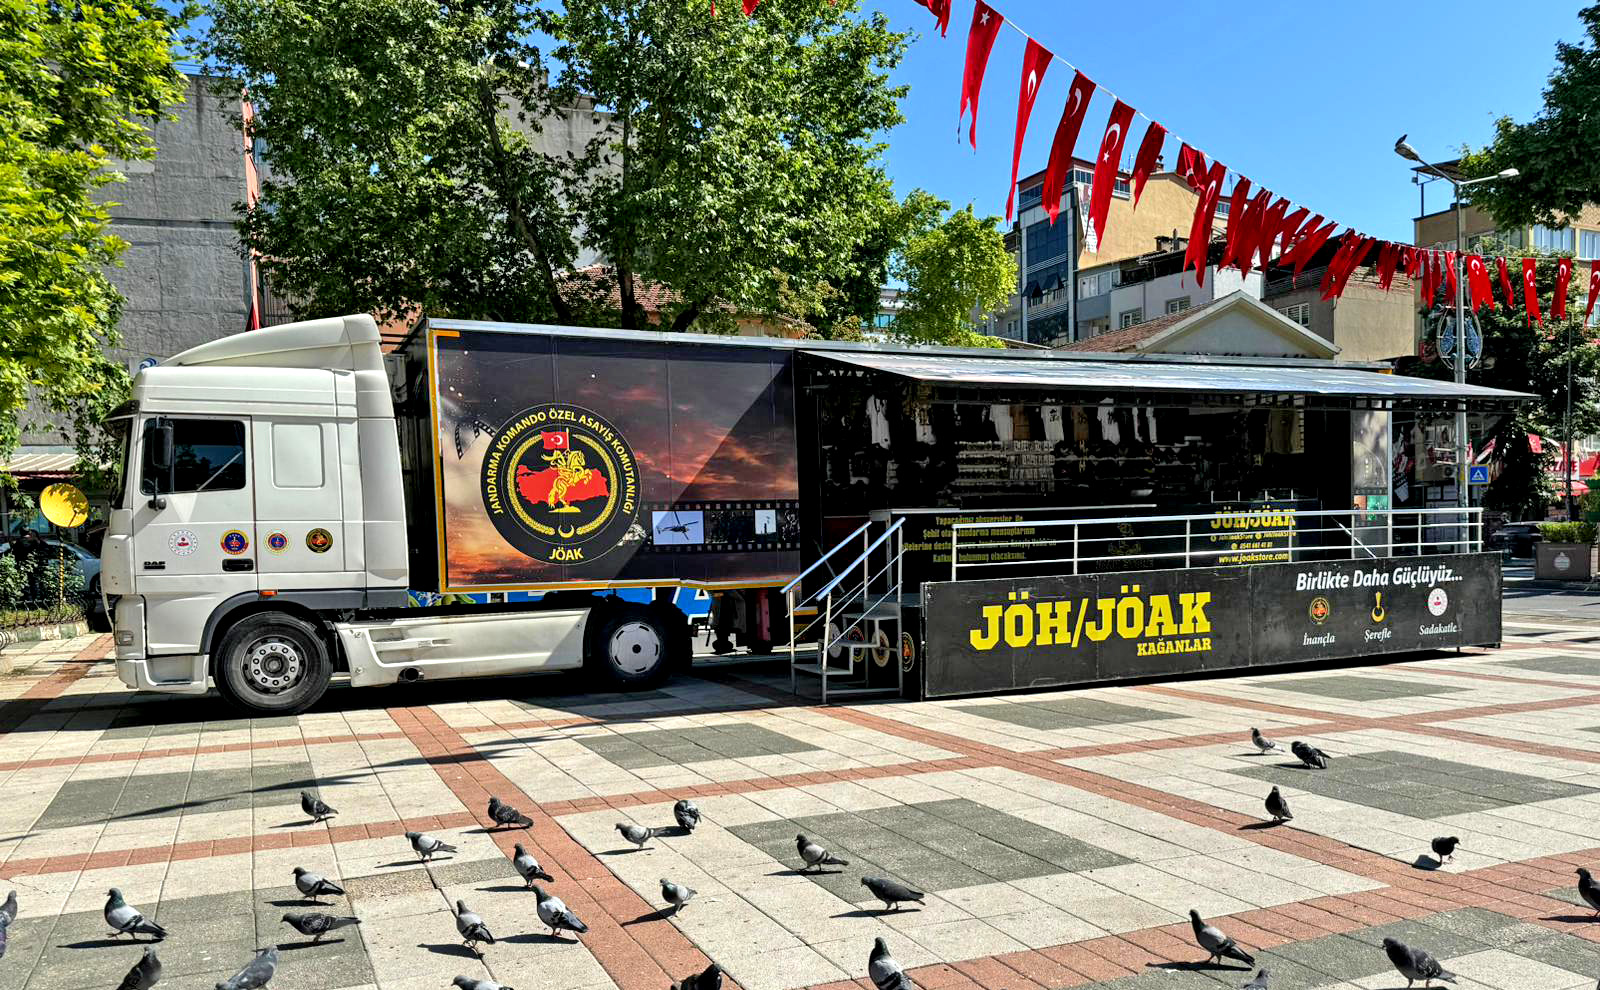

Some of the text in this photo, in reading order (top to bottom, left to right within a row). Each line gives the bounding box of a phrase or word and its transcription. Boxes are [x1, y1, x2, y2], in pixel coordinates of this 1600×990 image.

[487, 408, 635, 515] JANDARMA KOMANDO ÖZEL ASAYİŞ KOMUTANLIĞI
[549, 547, 584, 561] JÖAK
[1296, 565, 1463, 591] Birlikte Daha Güçlüyüz...
[970, 585, 1211, 650] JÖH/JÖAK
[1364, 627, 1392, 643] Şerefle
[1419, 622, 1457, 636] Sadakatle
[1137, 638, 1212, 656] KAĞANLAR
[1303, 632, 1335, 647] İnançla
